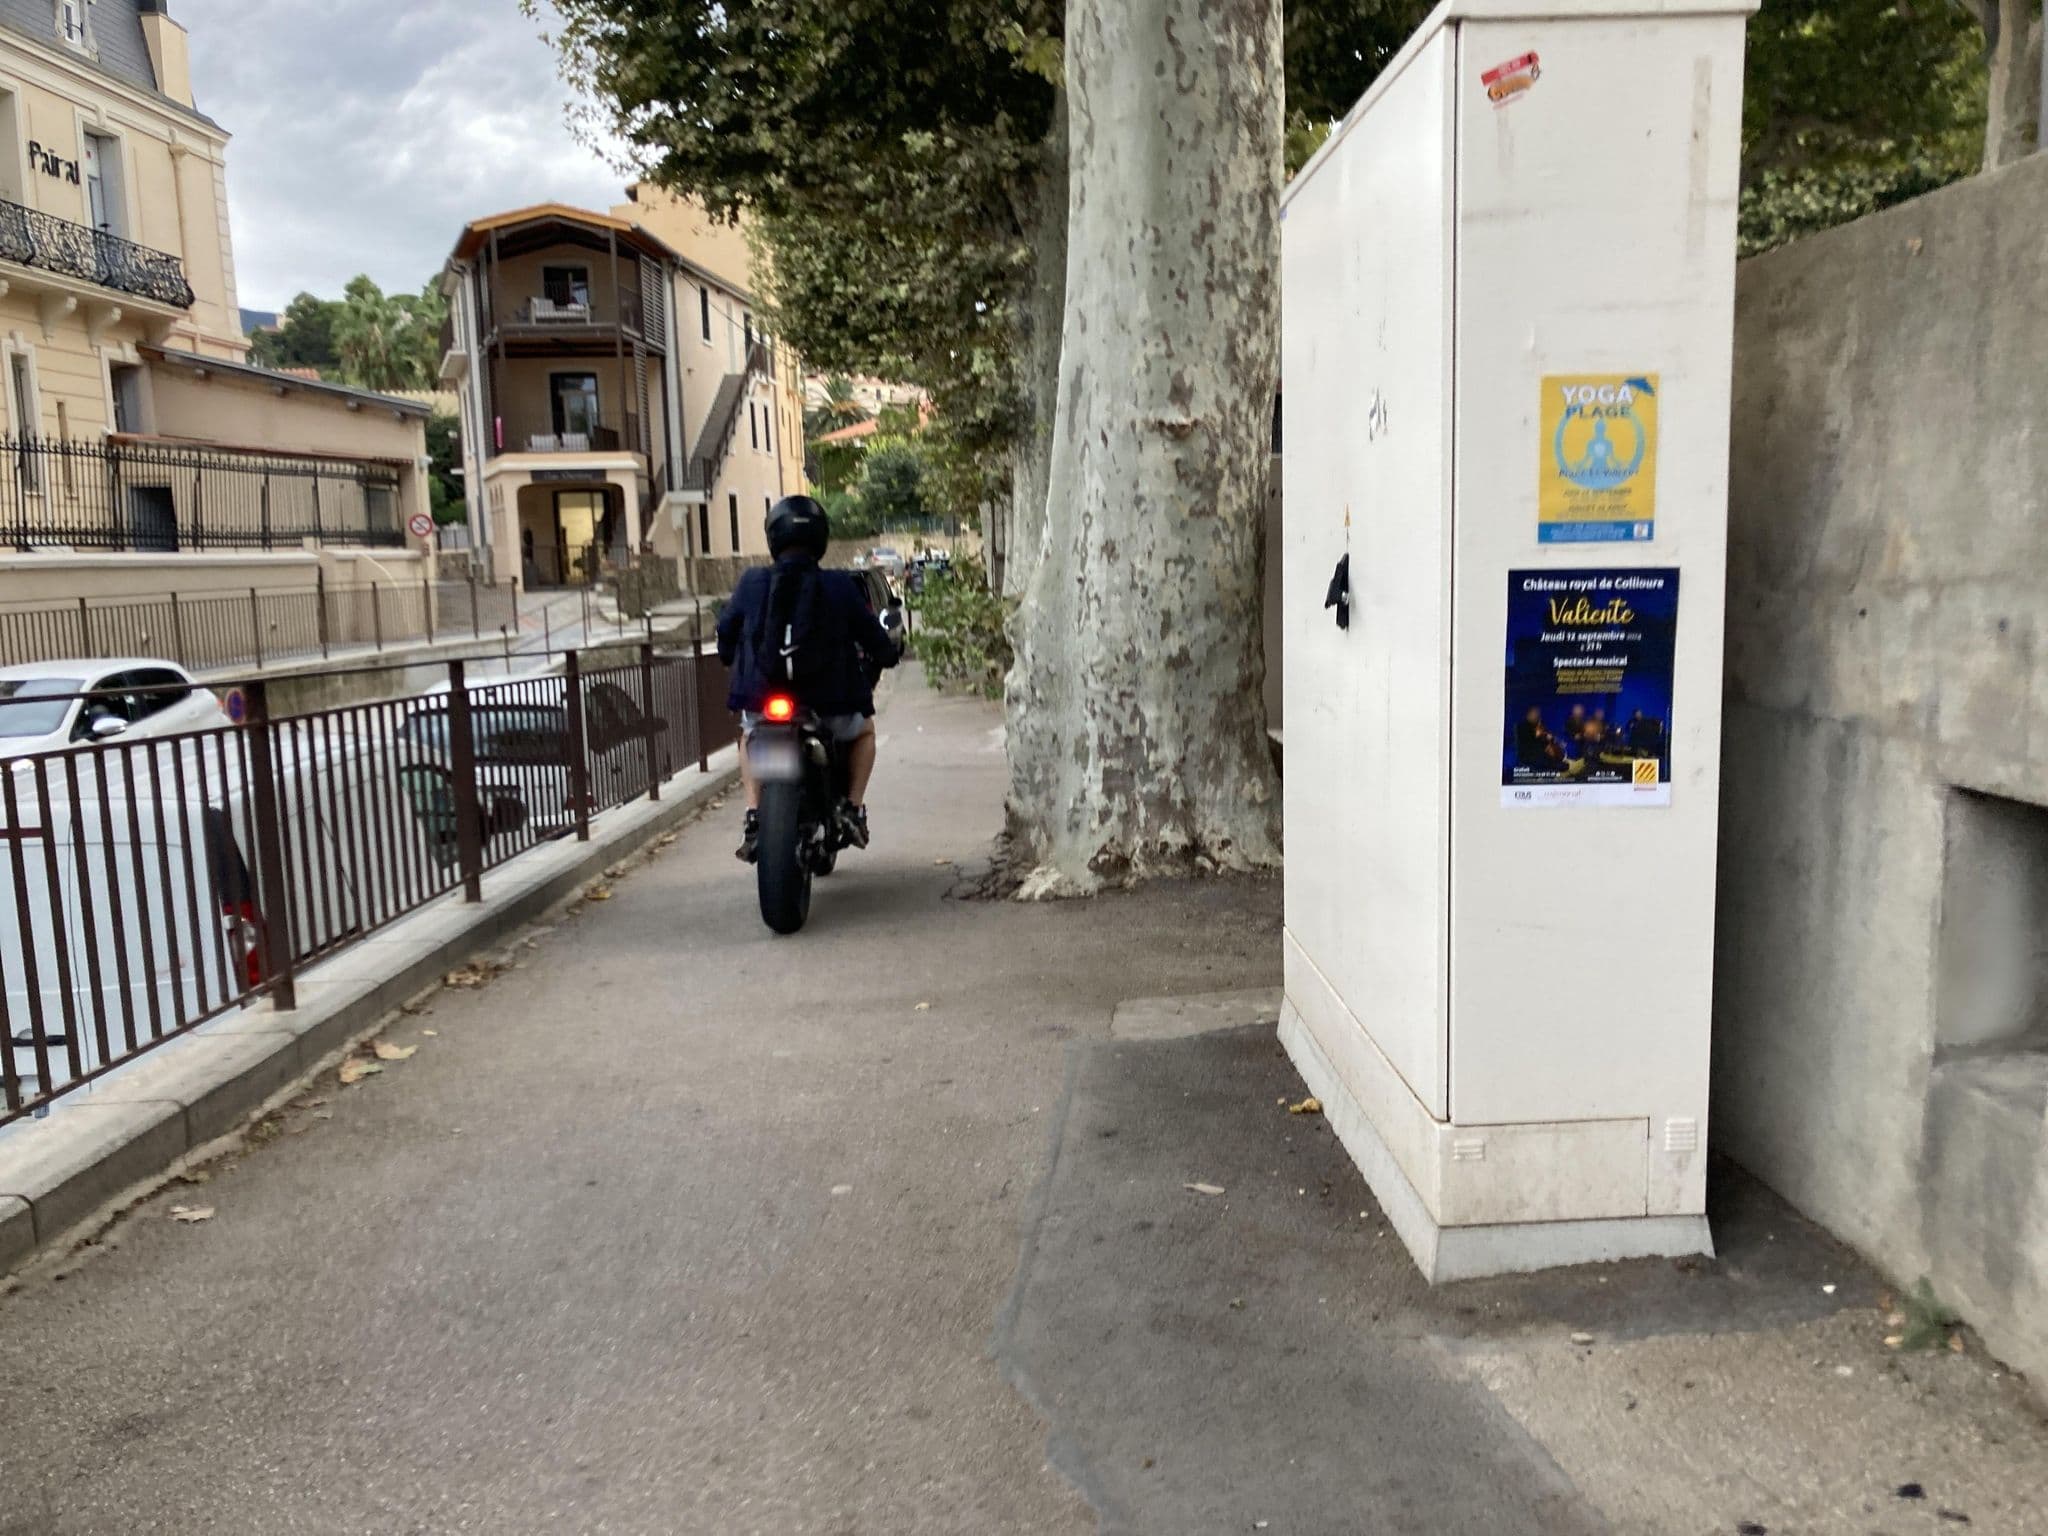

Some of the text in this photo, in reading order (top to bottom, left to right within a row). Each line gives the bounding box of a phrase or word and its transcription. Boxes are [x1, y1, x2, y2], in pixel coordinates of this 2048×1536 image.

[1561, 383, 1633, 405] YOGA
[1523, 576, 1665, 593] Château royal de Collioure
[1550, 597, 1635, 625] Valiente
[1540, 631, 1565, 642] Jeudi
[1578, 631, 1625, 644] septembre
[1553, 655, 1628, 668] Spectacle musical
